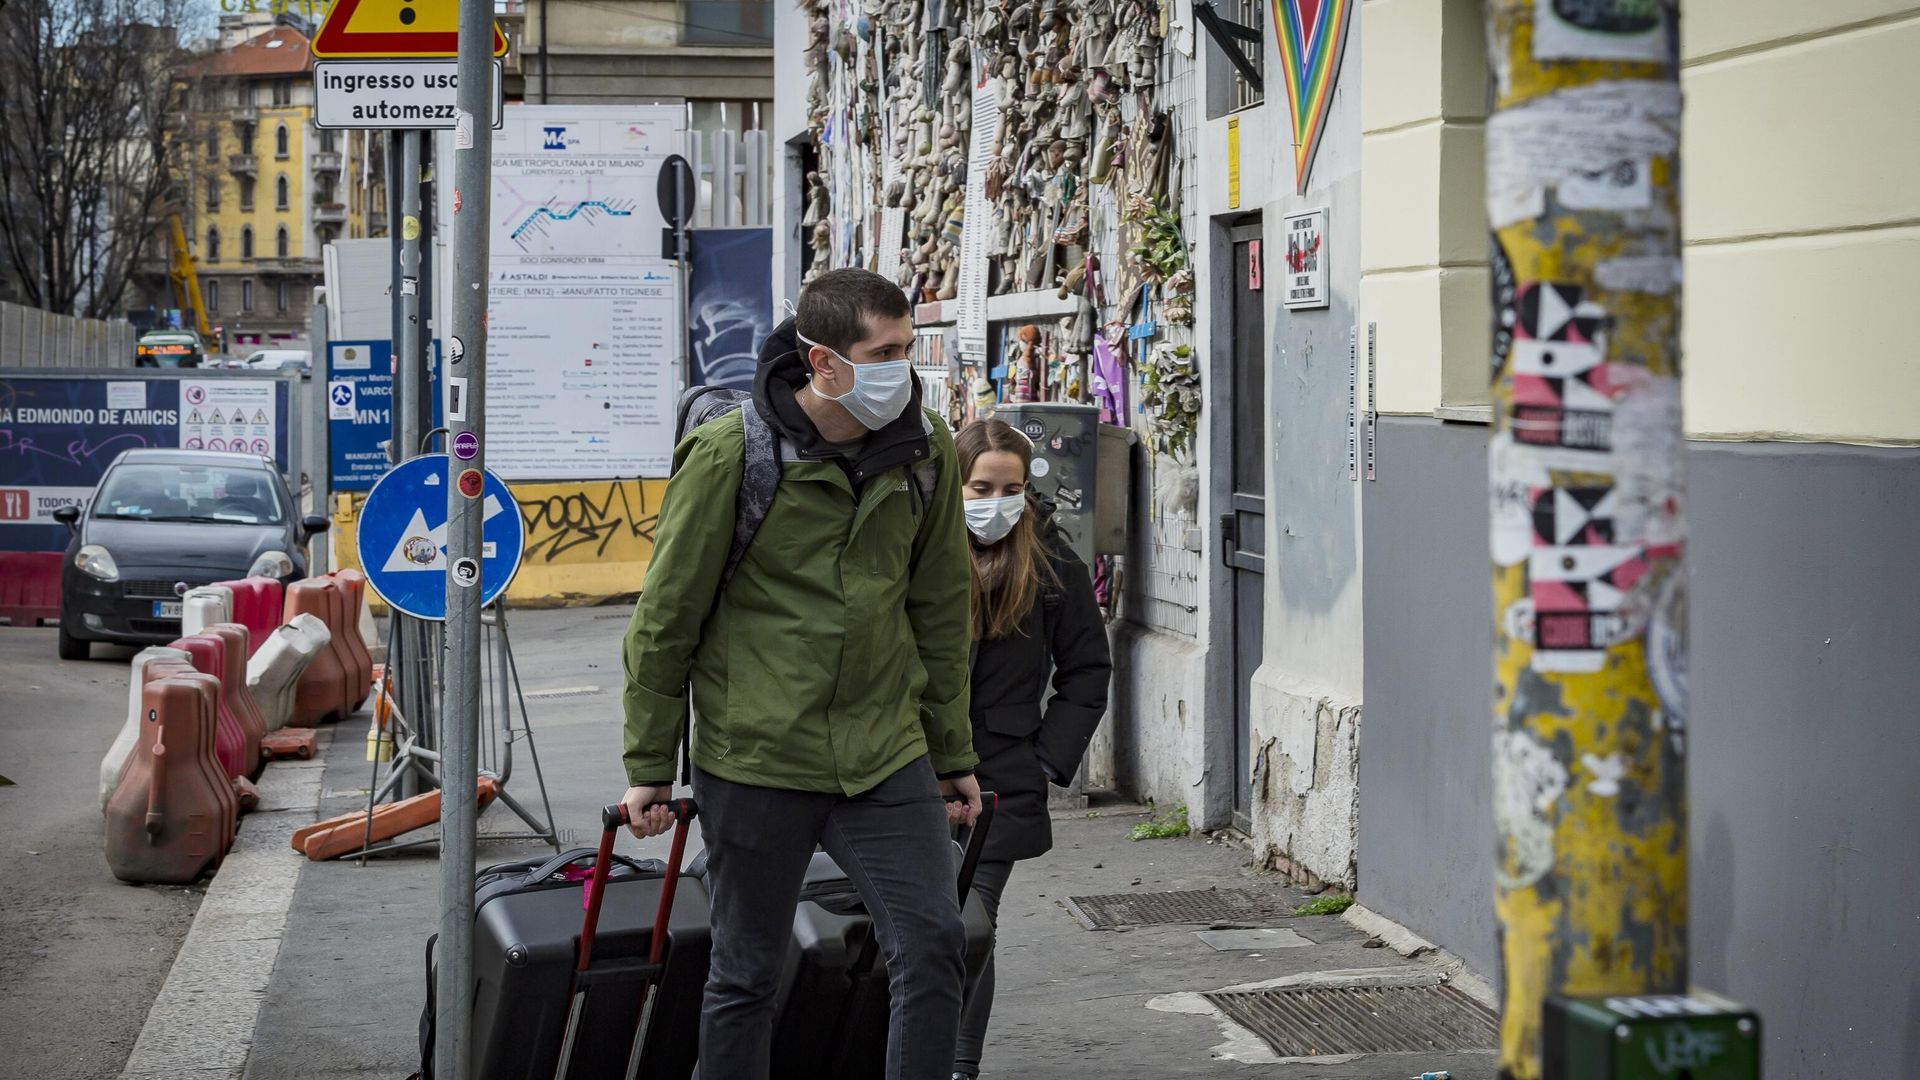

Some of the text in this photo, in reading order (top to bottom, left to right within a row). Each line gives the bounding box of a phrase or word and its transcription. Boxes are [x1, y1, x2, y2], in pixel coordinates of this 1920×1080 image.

[323, 71, 415, 93] ingresso
[352, 100, 457, 119] automezz
[509, 160, 588, 168] METROPOLITANA
[609, 160, 644, 168] MILANO
[561, 288, 618, 296] MANUFATTO
[619, 288, 663, 296] TICINESE
[369, 374, 392, 382] Metro
[360, 386, 392, 396] VARC
[17, 408, 94, 424] EDMONDO
[98, 409, 119, 424] DE
[123, 409, 177, 425] AMICIS
[353, 408, 390, 425] MN1
[344, 452, 386, 460] MANUFATT
[76, 498, 83, 507] A
